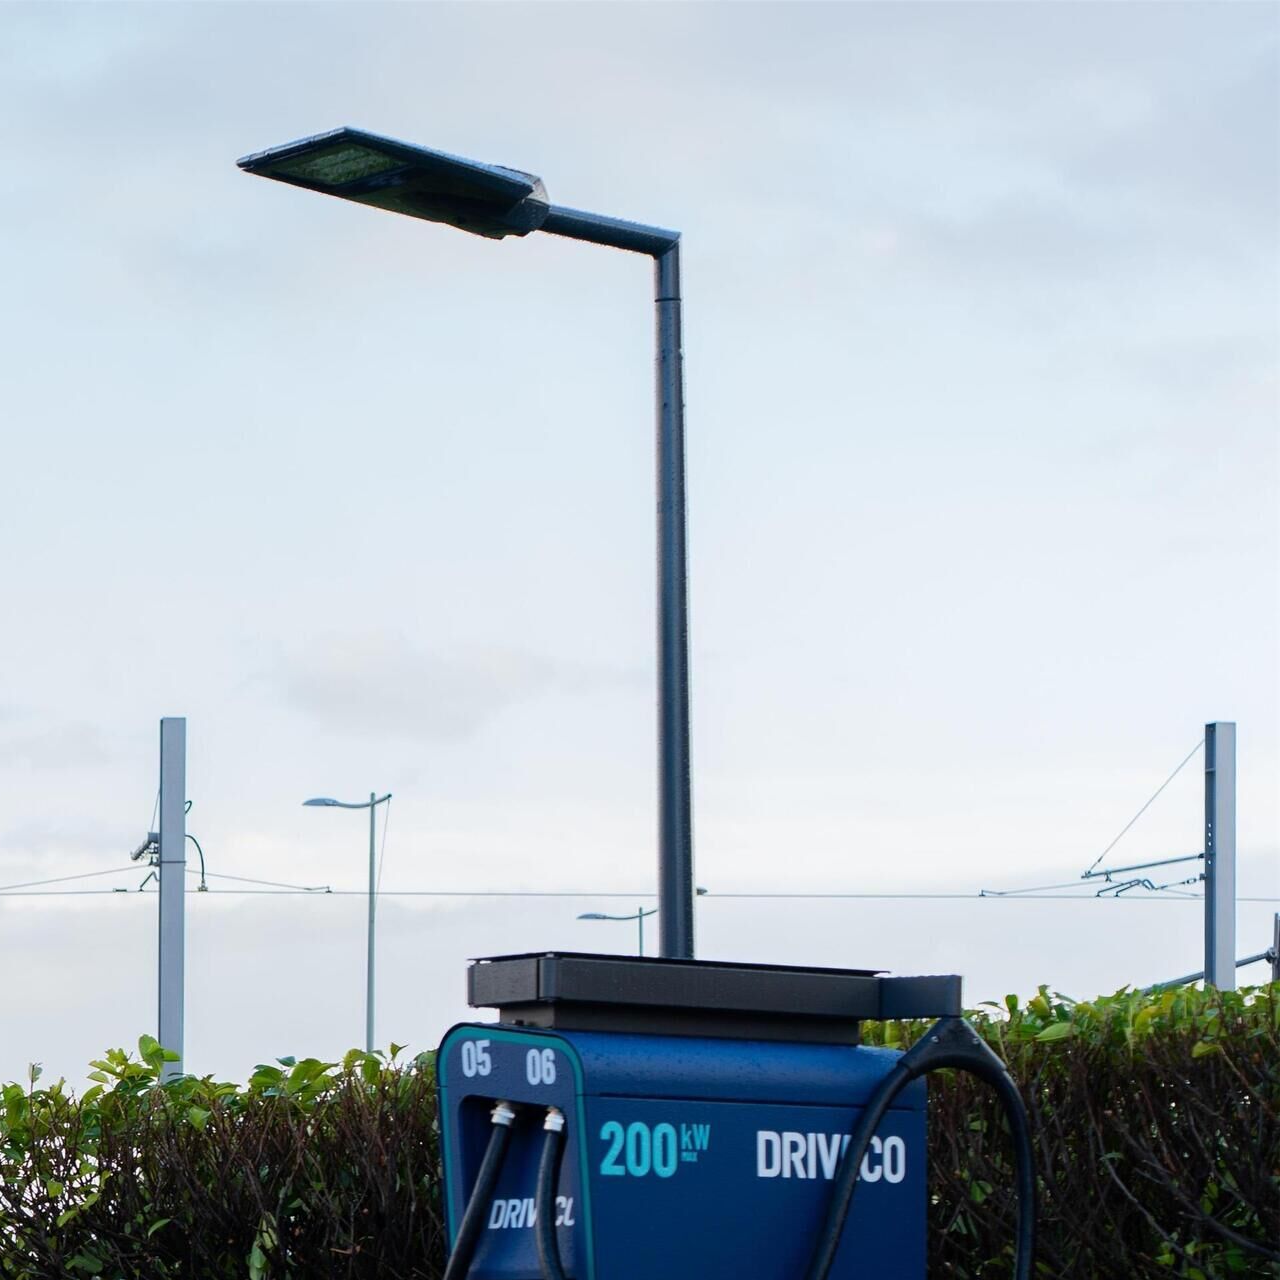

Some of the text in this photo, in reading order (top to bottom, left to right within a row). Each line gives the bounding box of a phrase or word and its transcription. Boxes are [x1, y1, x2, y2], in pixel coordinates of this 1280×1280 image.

[461, 1040, 492, 1077] 05
[526, 1048, 556, 1086] 06
[600, 1120, 711, 1178] 200 kW
[757, 1130, 906, 1183] DRIVCO
